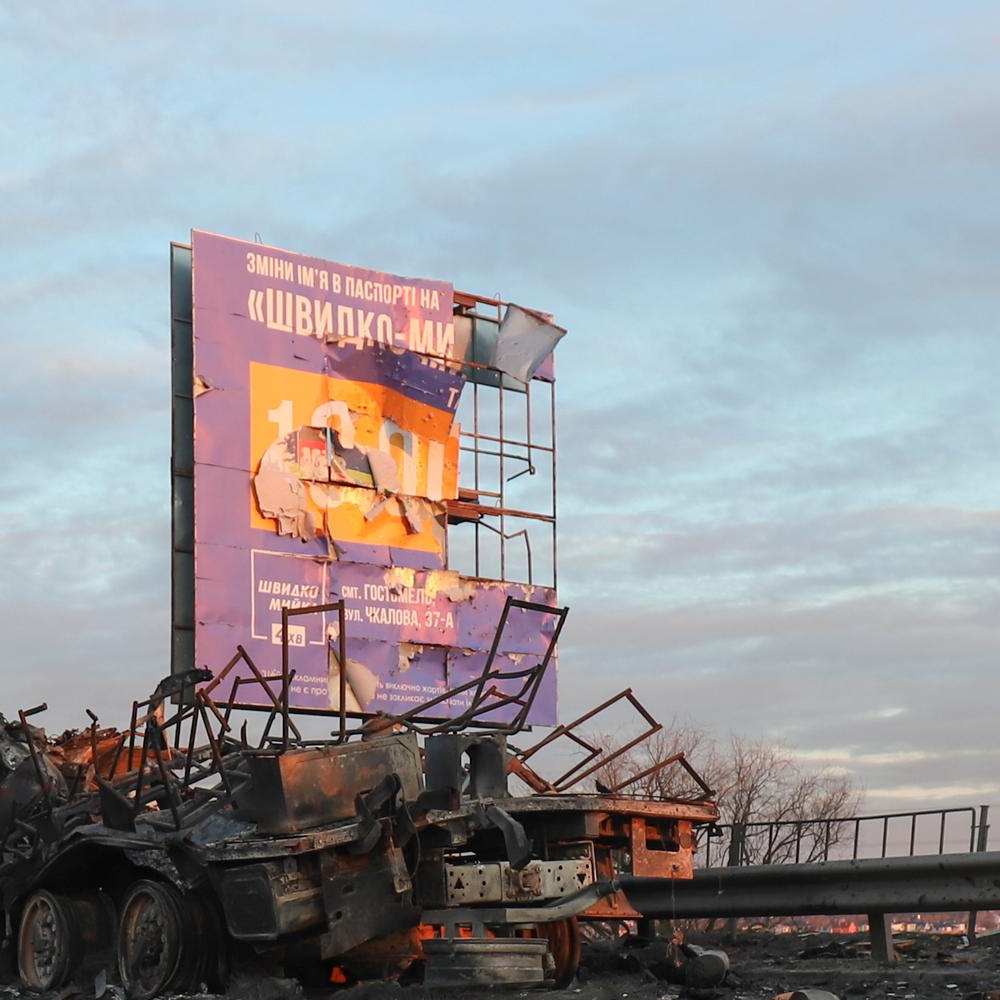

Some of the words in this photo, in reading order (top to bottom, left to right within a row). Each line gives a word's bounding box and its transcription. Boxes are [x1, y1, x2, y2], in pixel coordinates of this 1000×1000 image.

[246, 252, 294, 281] ЗМІНИ
[332, 273, 341, 294] В
[345, 276, 416, 307] ПАСПОРТІ
[420, 288, 440, 311] НА
[247, 288, 456, 364] «ШВИДКО-МИ
[257, 579, 320, 599] ШВИДКО
[268, 598, 318, 615] МИЙК
[365, 606, 421, 628] ЧКАЛОВА,
[311, 687, 329, 697] про
